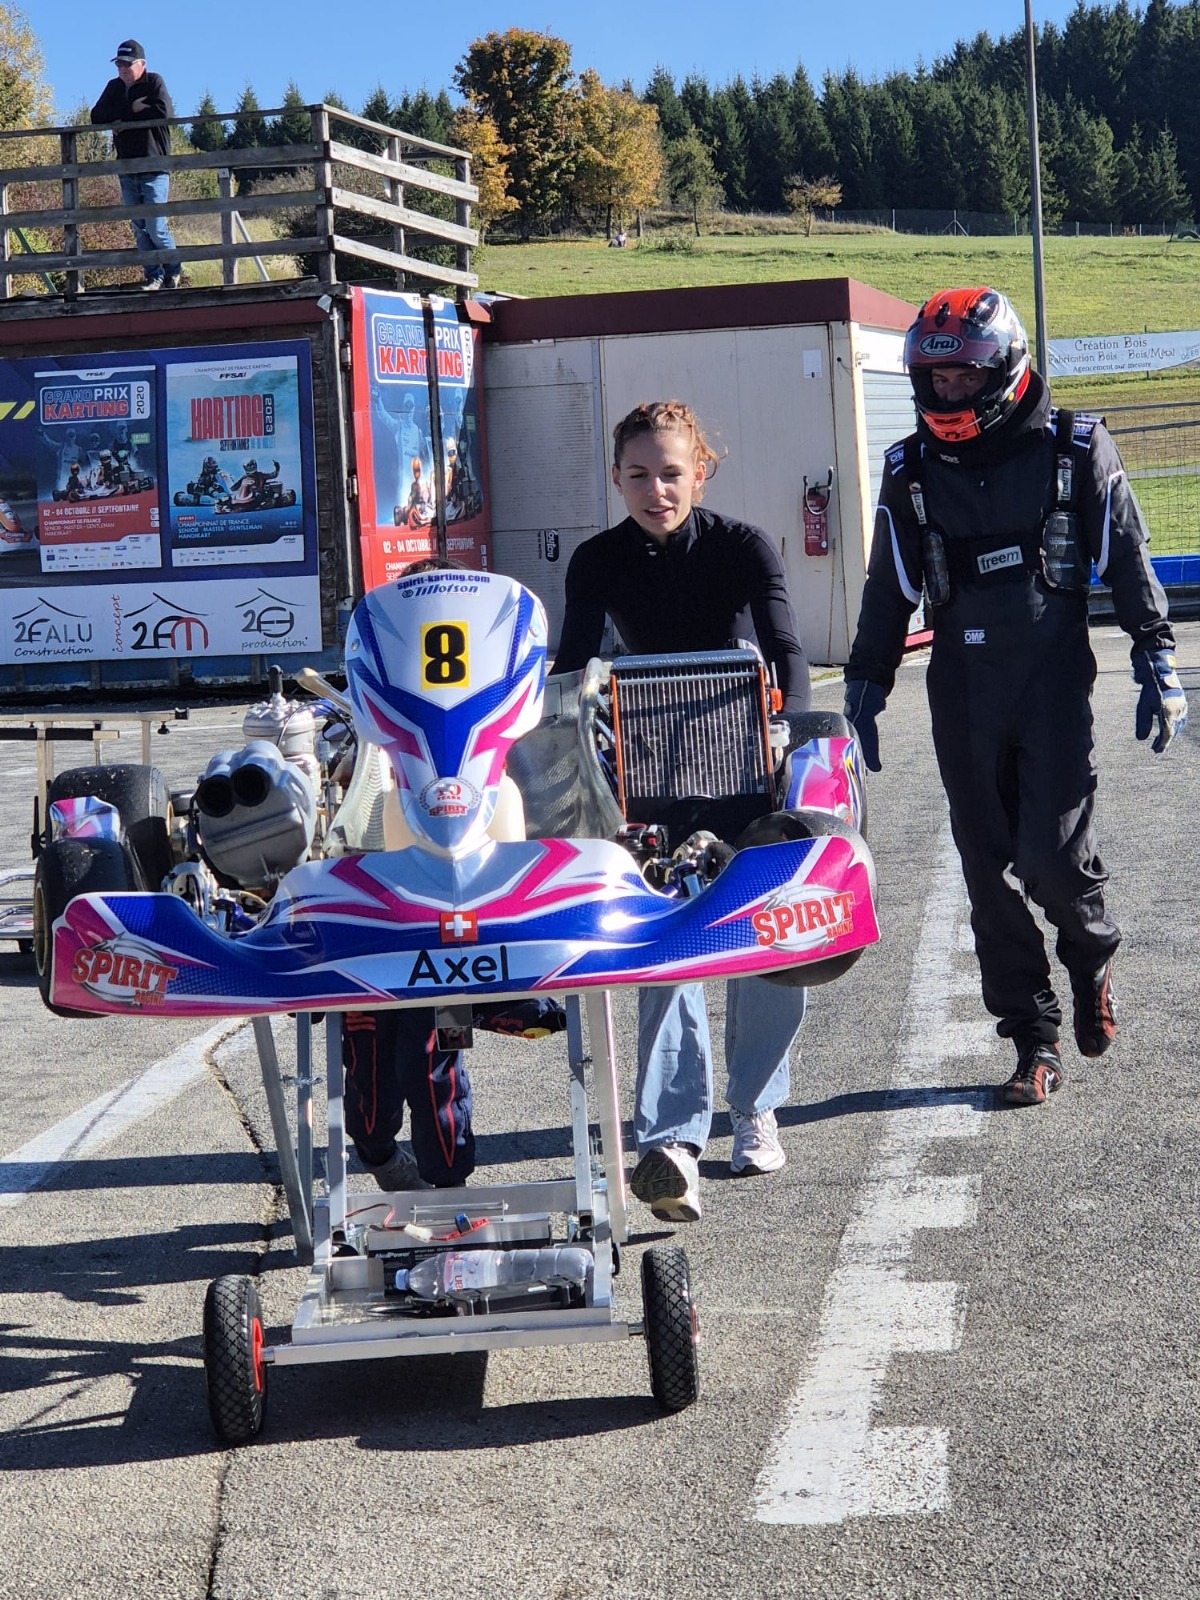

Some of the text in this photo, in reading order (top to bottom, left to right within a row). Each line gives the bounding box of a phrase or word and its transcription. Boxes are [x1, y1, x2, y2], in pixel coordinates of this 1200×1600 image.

[377, 322, 461, 350] GRAND PRIX
[921, 337, 956, 350] Arai
[1074, 336, 1148, 351] Création Bois
[379, 345, 463, 378] KARTING
[1098, 350, 1118, 361] Bois
[1072, 362, 1114, 373] Agencement
[44, 386, 128, 403] GRAND PRIX
[136, 386, 145, 414] 2020
[44, 400, 129, 420] KARTING
[191, 394, 264, 441] KARTING
[265, 397, 273, 433] 2023
[178, 520, 218, 528] CHAMPIONNAT
[382, 541, 392, 554] 02
[396, 540, 405, 553] 04
[981, 551, 1020, 571] freem
[397, 573, 490, 590] spirit-karting.com
[415, 583, 479, 597] Tillotson
[964, 631, 985, 642] OMP
[14, 646, 94, 657] Construction
[424, 625, 467, 684] 8
[429, 804, 468, 816] SPIRIT
[752, 891, 855, 947] SPIRIT
[826, 920, 853, 940] RACING
[72, 948, 179, 994] SPIRIT
[407, 944, 509, 987] Axel
